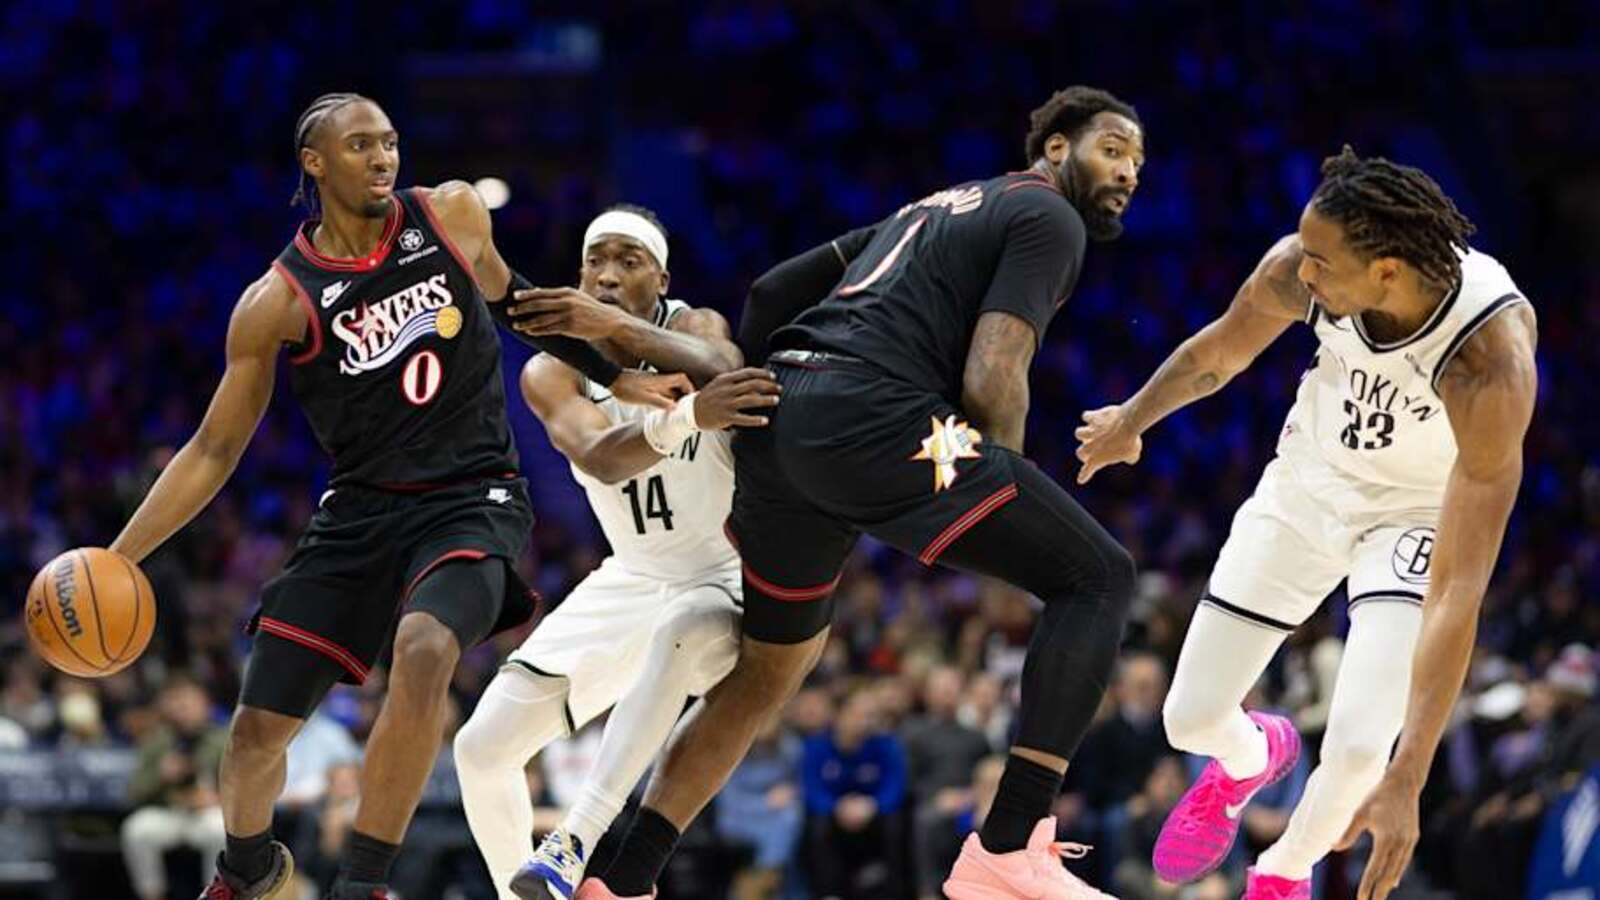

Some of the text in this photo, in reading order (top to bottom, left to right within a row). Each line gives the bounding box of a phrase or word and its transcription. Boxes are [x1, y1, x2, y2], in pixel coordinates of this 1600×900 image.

[401, 348, 443, 406] 0
[622, 474, 674, 534] 14
[1407, 537, 1434, 575] B
[54, 558, 83, 637] Wilson
